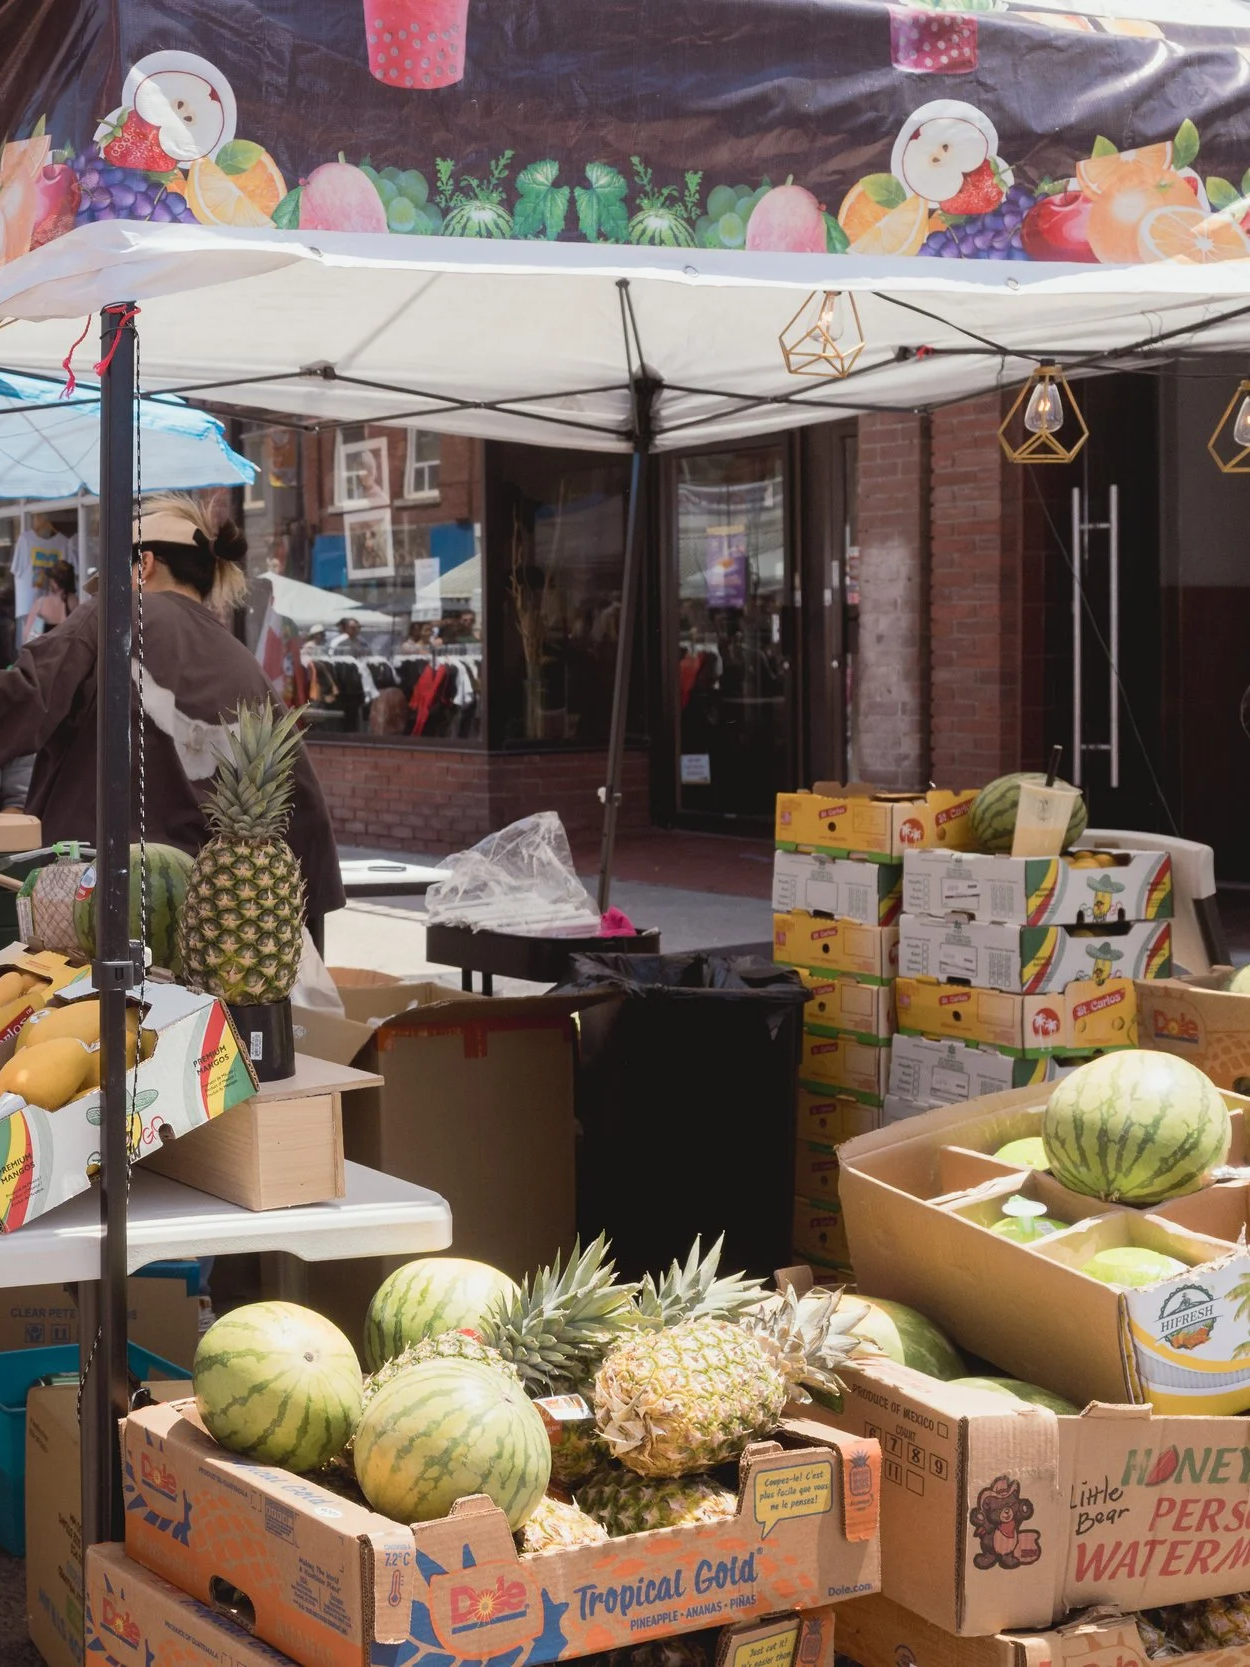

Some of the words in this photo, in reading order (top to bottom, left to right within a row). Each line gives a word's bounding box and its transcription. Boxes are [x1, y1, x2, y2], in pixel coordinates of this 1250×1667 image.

[1091, 993, 1121, 1010] Carlos
[1154, 1010, 1198, 1038] Dole
[192, 1045, 227, 1068] PREMIUM
[196, 1054, 230, 1076] MANGOS
[0, 1161, 36, 1185] MANGOS
[10, 1308, 46, 1318] CLEAR
[1161, 1304, 1214, 1333] HIFRESH
[852, 1384, 889, 1410] PRODUCE
[891, 1402, 900, 1415] OF
[903, 1408, 934, 1431] MEXICO
[895, 1425, 916, 1441] COUNT
[890, 1439, 897, 1452] 7
[911, 1448, 920, 1464] 8
[934, 1460, 943, 1475] 9
[141, 1452, 177, 1494] Dole
[764, 1472, 803, 1487] Coupez-le!
[806, 1470, 824, 1480] C'est
[759, 1490, 774, 1503] plus
[777, 1486, 796, 1496] facile
[799, 1486, 811, 1496] que
[782, 1500, 788, 1508] le
[790, 1495, 818, 1510] pensez!
[1069, 1475, 1124, 1510] Little
[1075, 1507, 1130, 1536] Bear
[317, 1565, 325, 1576] The
[385, 1552, 411, 1567] 7.2°C
[450, 1576, 527, 1626] Dole
[573, 1569, 686, 1621] Tropical
[103, 1597, 141, 1647] Dole
[630, 1604, 679, 1631] PINEAPPLE
[686, 1600, 723, 1618] ANANAS
[729, 1594, 757, 1610] PIÑAS
[750, 1648, 763, 1658] Just
[766, 1643, 776, 1651] cut
[779, 1637, 788, 1648] it!
